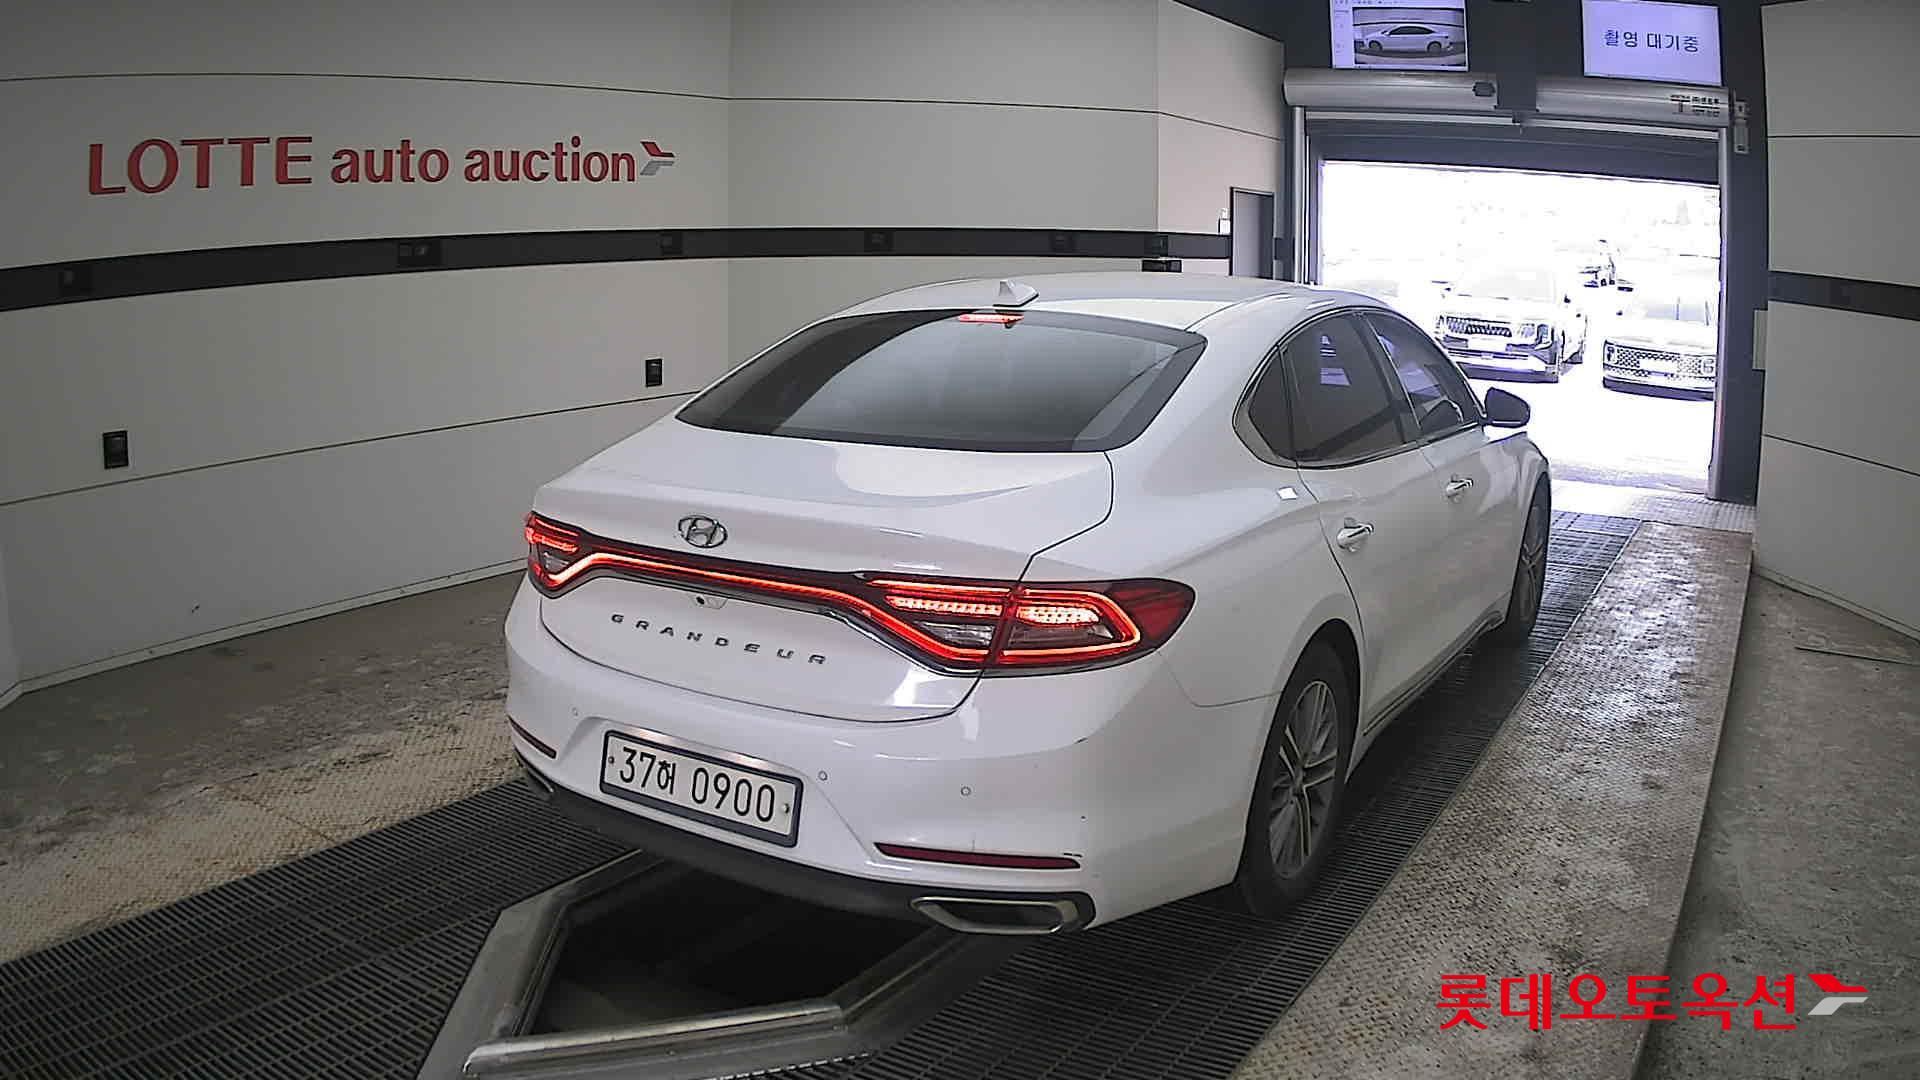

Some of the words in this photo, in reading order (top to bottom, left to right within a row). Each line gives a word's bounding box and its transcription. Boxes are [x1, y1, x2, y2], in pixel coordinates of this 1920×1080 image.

[1604, 28, 1639, 48] 촬영
[1646, 31, 1700, 53] 대기중
[88, 136, 313, 195] LOTTE
[331, 140, 450, 184] auto
[464, 136, 636, 183] auction
[611, 613, 827, 665] GRANDEUR
[620, 746, 677, 796] 37허
[691, 767, 776, 823] 0900
